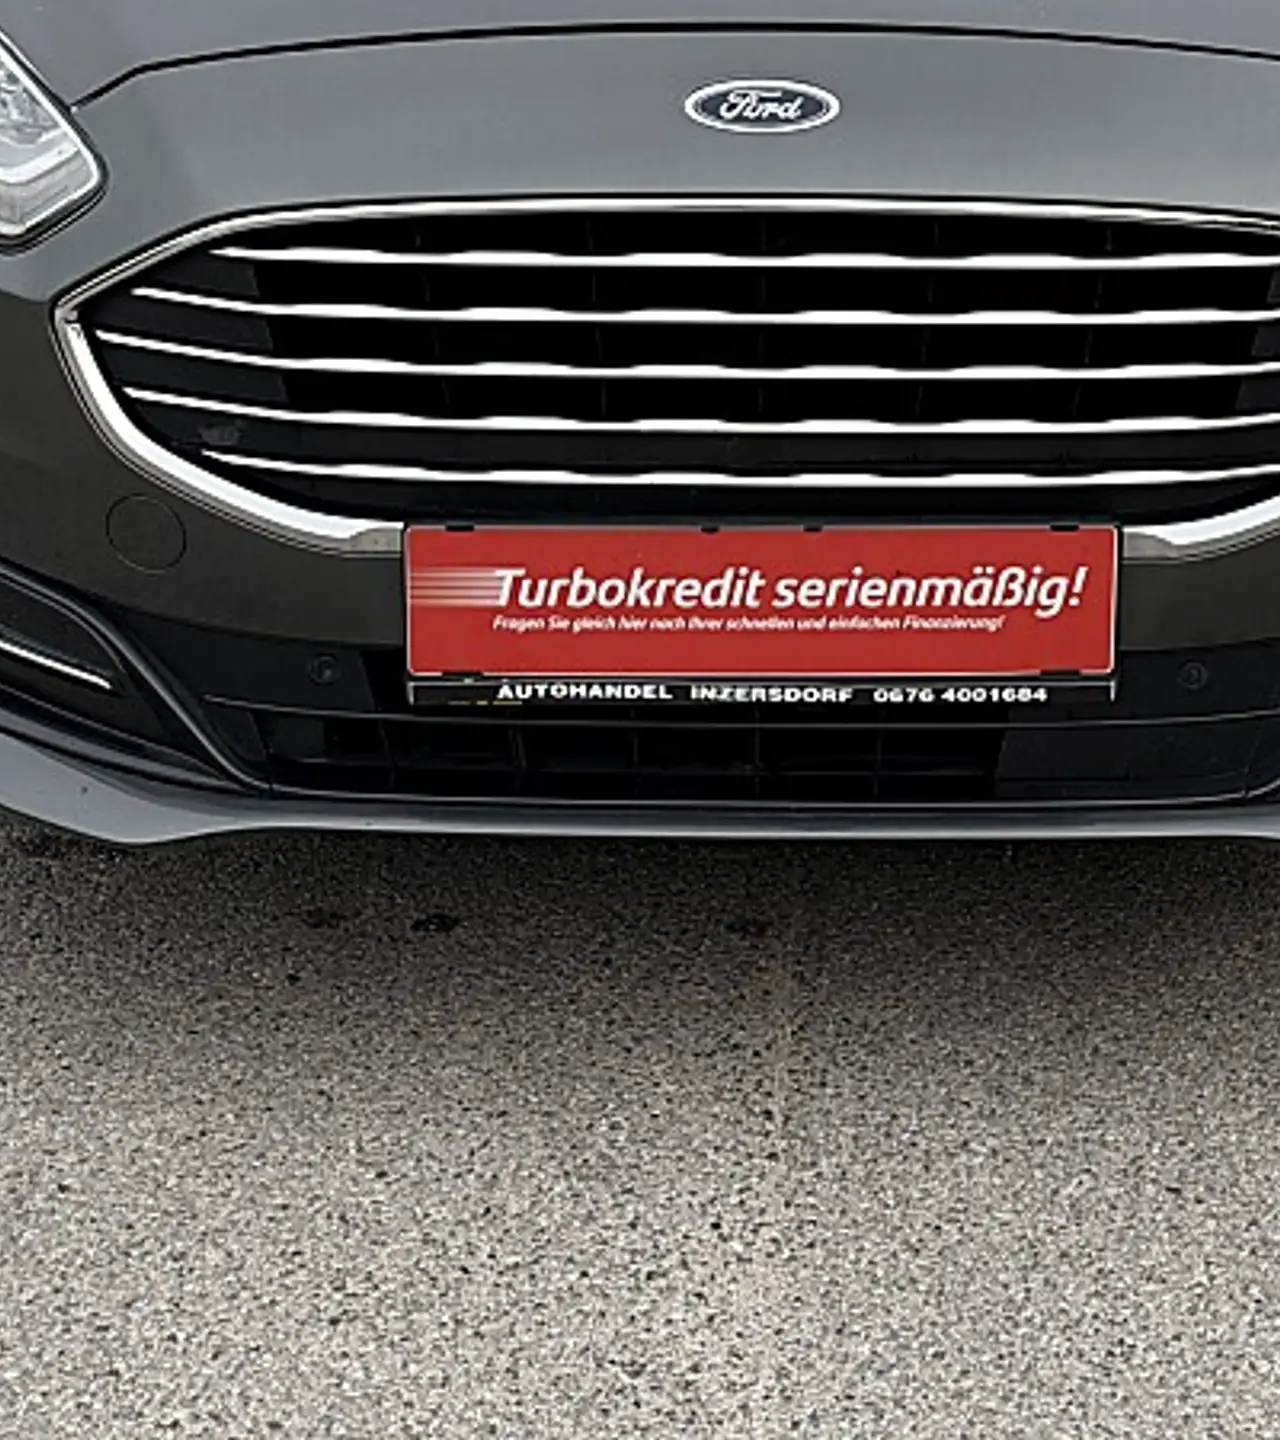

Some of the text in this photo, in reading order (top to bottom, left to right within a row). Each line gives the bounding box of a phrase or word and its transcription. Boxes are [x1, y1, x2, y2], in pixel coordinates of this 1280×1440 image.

[719, 90, 804, 120] Ford
[493, 565, 1089, 618] Turbokredit serienmäßig!
[493, 615, 545, 634] Fragen
[548, 615, 570, 630] Sie
[572, 615, 616, 633] gleich
[618, 615, 648, 630] hier
[650, 616, 686, 630] nach
[726, 616, 795, 631] schnellen
[797, 615, 827, 630] und
[829, 615, 900, 631] einfachen
[902, 614, 1006, 633] Finanzierung!
[497, 684, 1048, 702] AUTOHANDEL INZERSDORF 0676 4001684
